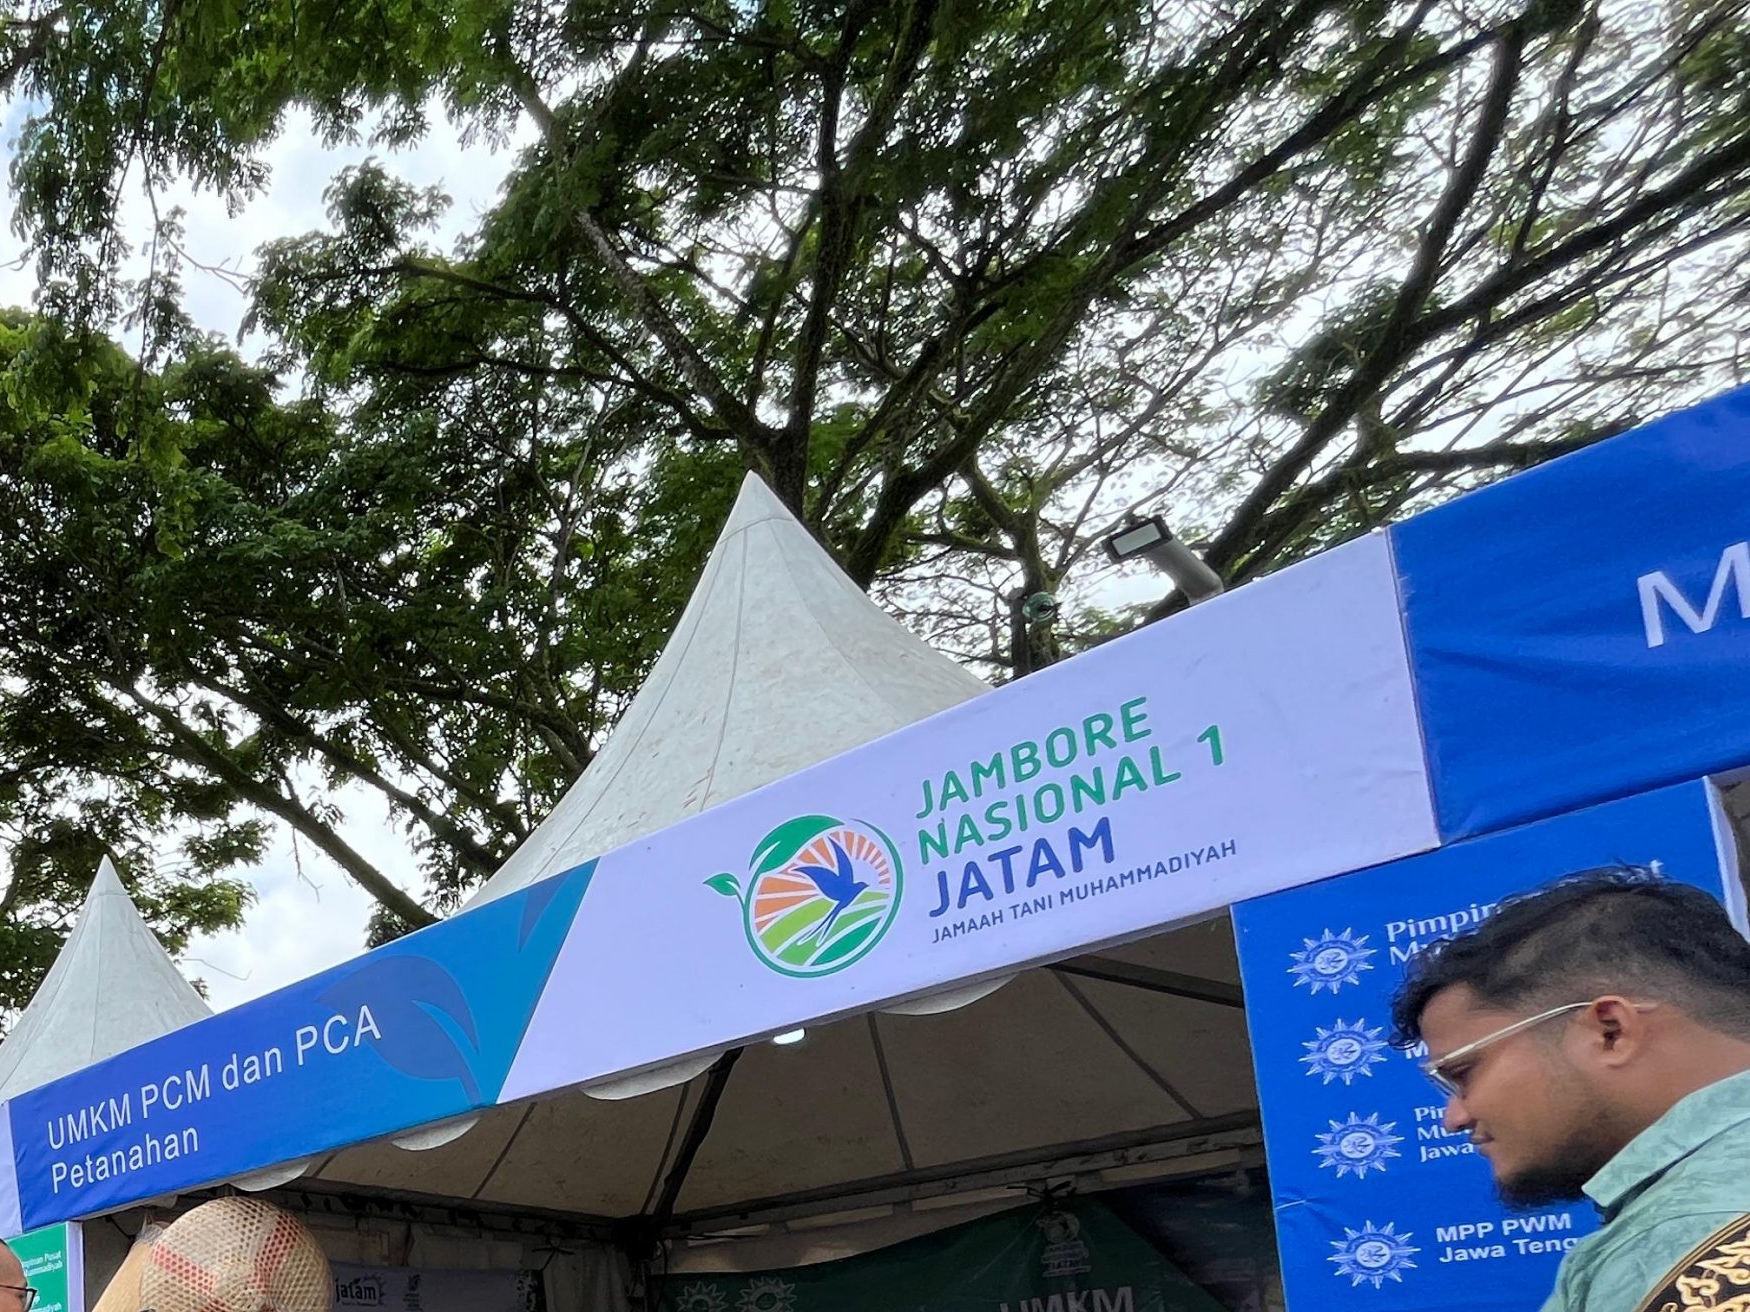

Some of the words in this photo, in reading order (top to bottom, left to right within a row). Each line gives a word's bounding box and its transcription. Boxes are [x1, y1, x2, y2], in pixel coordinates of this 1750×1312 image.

[916, 697, 1152, 819] JAMBORE
[918, 746, 1181, 865] NASIONAL
[1197, 725, 1224, 766] 1
[929, 817, 1116, 918] JATAM
[932, 910, 1004, 944] JAMAAH
[1009, 895, 1053, 920] TANI
[1059, 839, 1237, 906] MUHAMMADIYAH
[1385, 902, 1501, 942] Pimpin
[48, 1093, 132, 1151] UMKM
[141, 1064, 211, 1119] PCM
[222, 1046, 283, 1091] dan
[296, 1005, 382, 1066] PCA
[51, 1127, 199, 1194] Petanahan
[1436, 1222, 1494, 1242] MPP
[1501, 1213, 1572, 1236] PWM
[1439, 1243, 1505, 1263] Jawa
[1512, 1237, 1578, 1255] Teng
